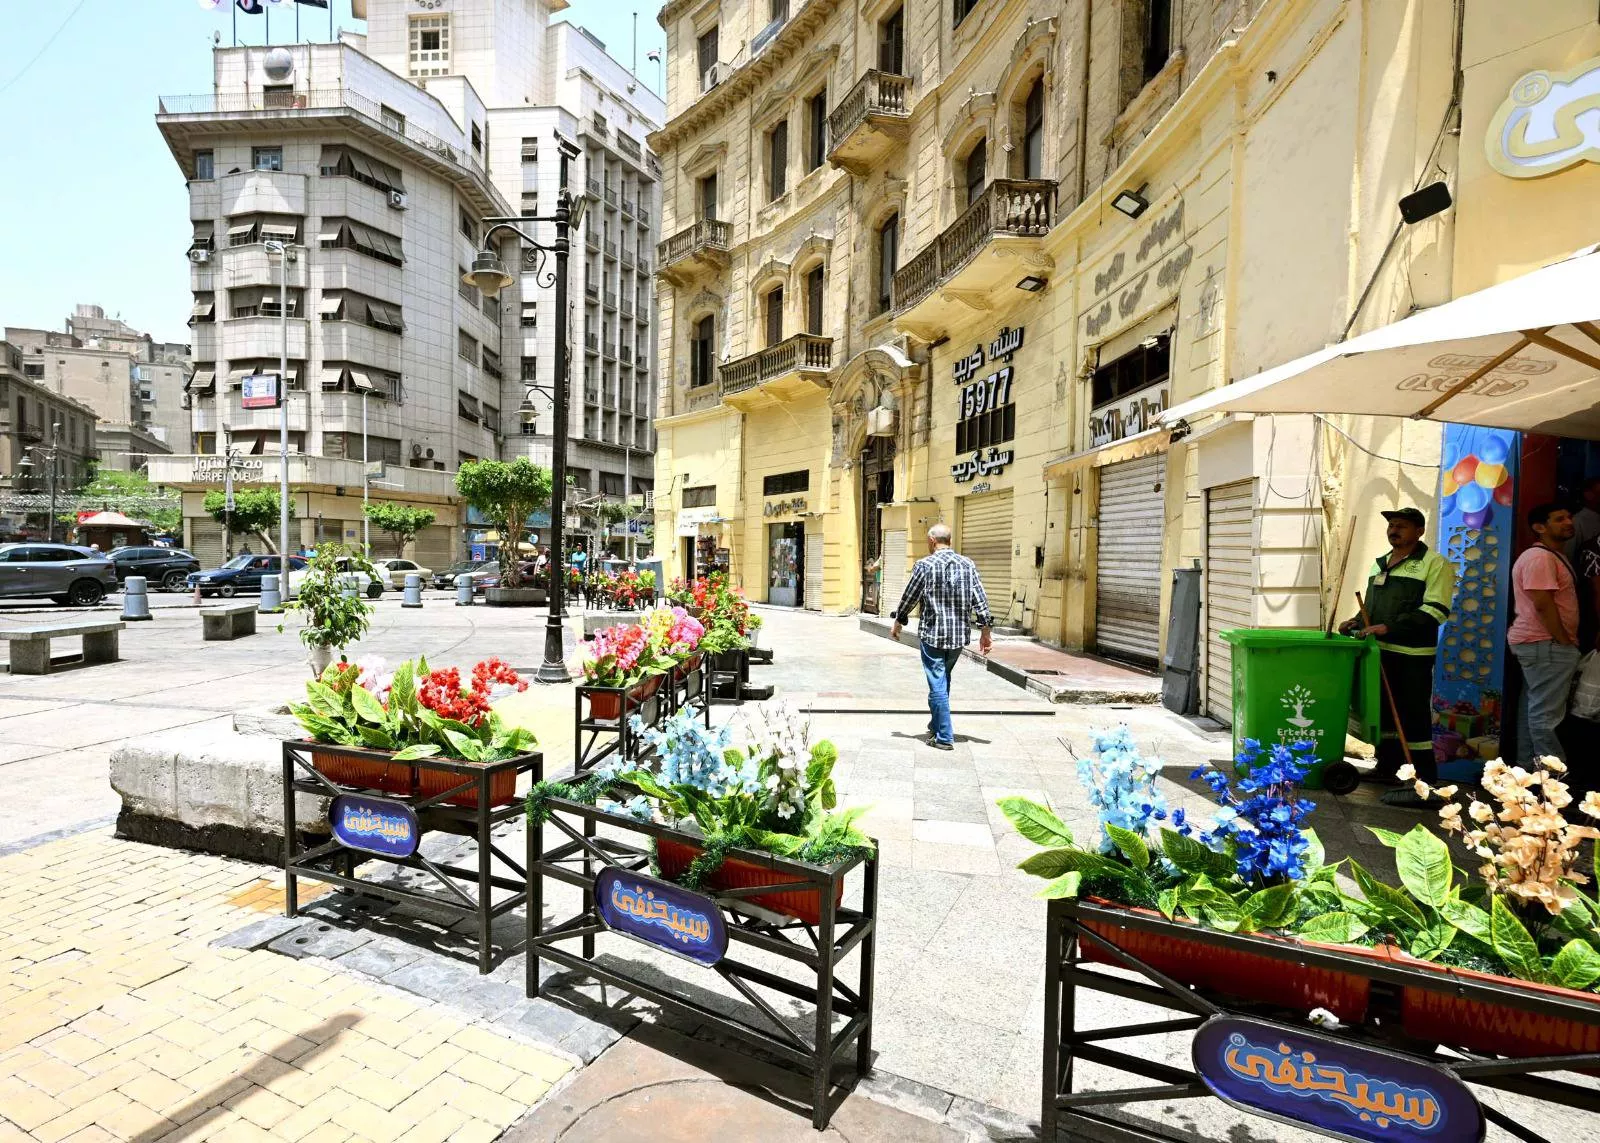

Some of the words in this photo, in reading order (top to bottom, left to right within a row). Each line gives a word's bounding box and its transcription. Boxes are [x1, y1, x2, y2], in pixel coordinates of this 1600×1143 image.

[953, 344, 984, 385] كريب
[959, 367, 1013, 420] 15977
[191, 471, 211, 481] MISR
[212, 471, 262, 481] PETOLEU
[951, 450, 982, 483] كريب
[660, 912, 708, 943] سيد
[1329, 1083, 1438, 1128] سيد
